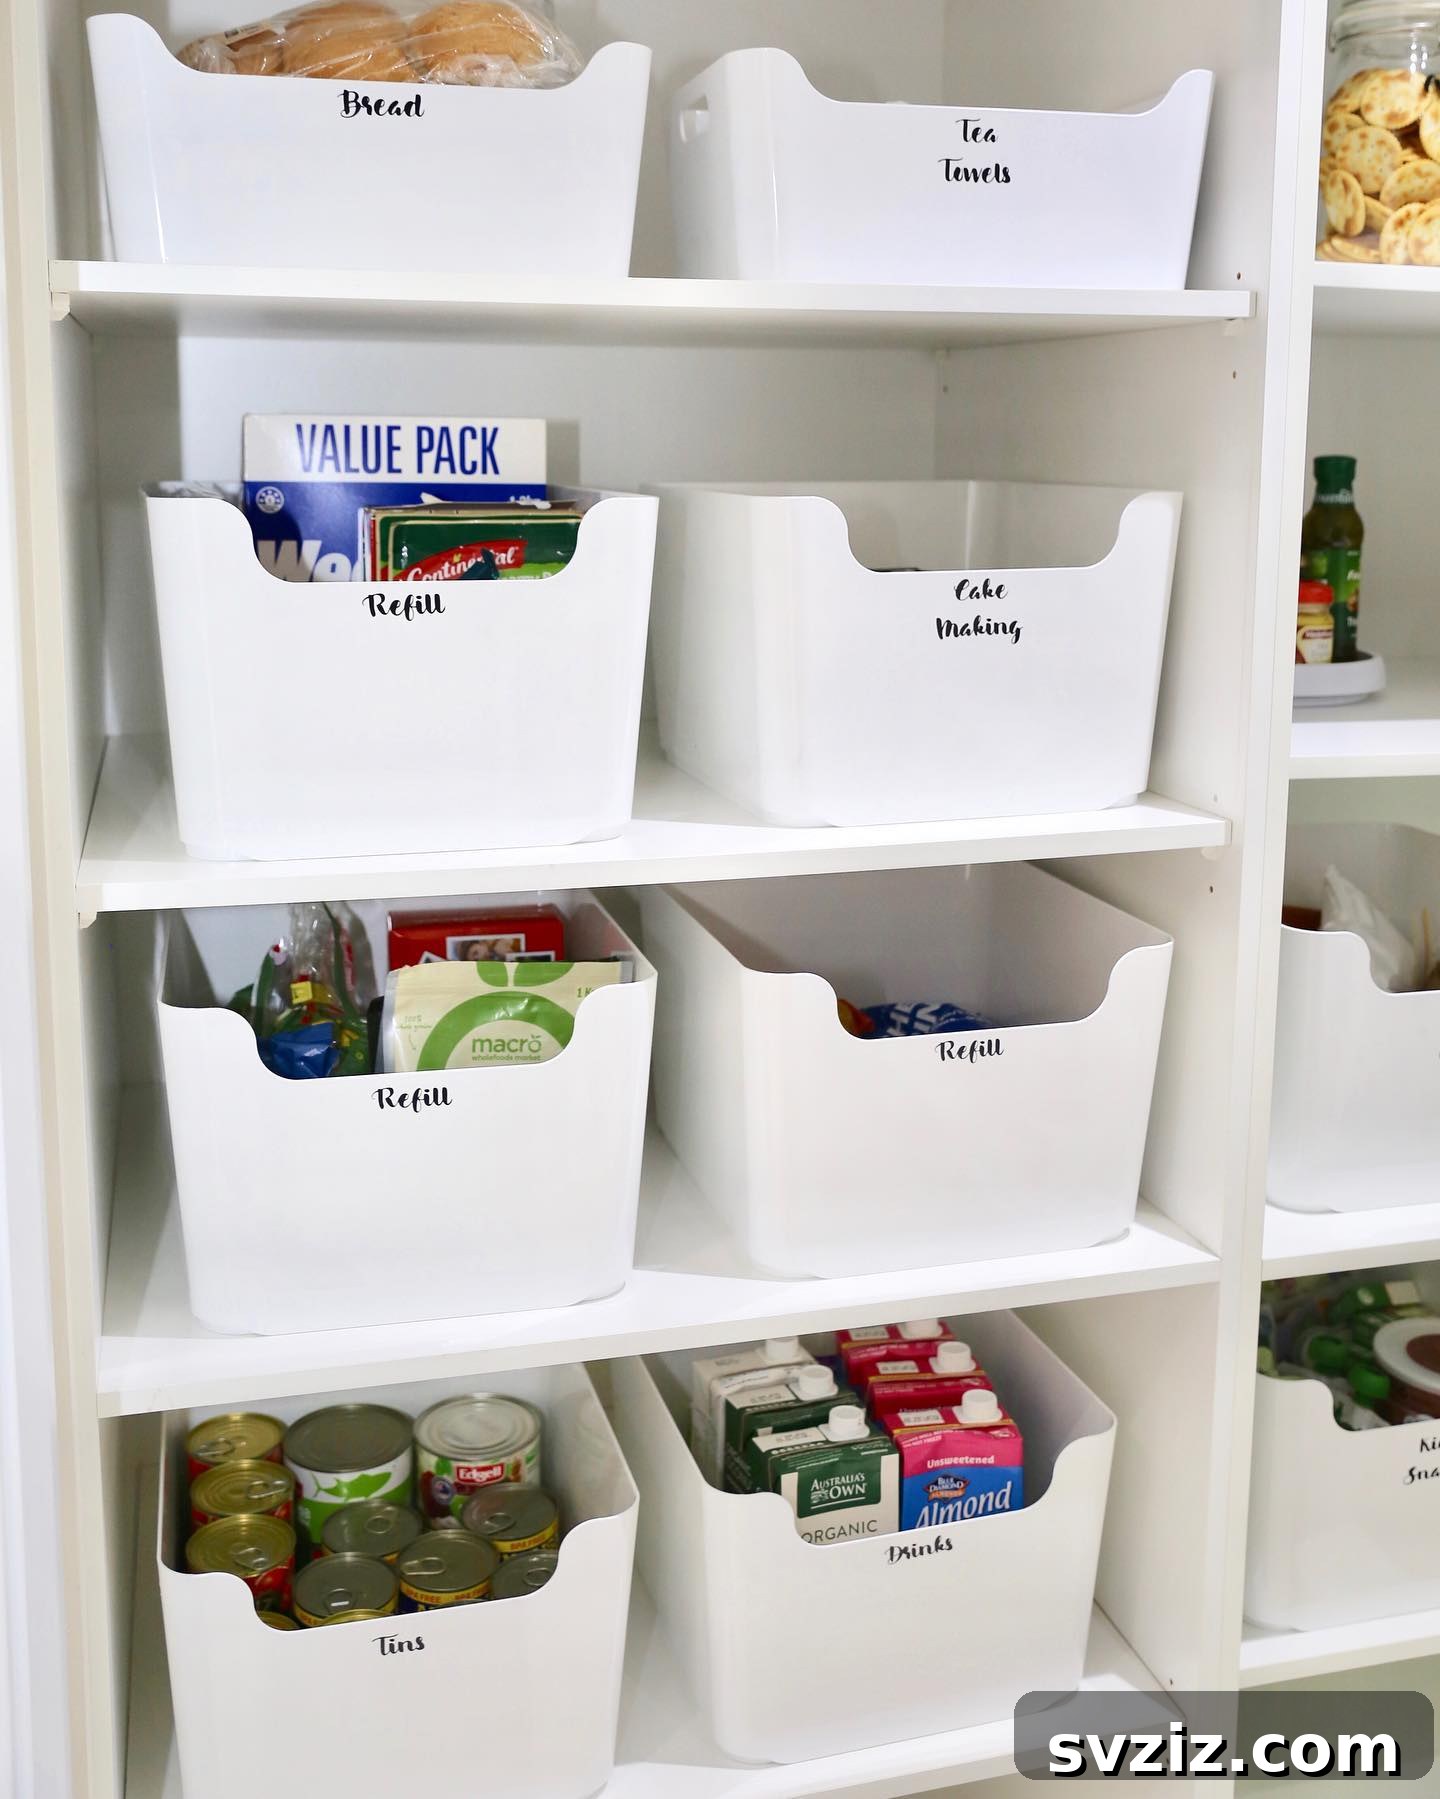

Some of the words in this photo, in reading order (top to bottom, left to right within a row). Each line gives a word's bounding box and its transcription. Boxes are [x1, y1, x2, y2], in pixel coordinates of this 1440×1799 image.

[337, 89, 425, 119] Bread
[955, 118, 999, 143] Tea
[937, 157, 1011, 184] Towels
[296, 423, 402, 474] VALUE
[416, 425, 500, 476] PACK
[257, 539, 371, 582] We
[953, 578, 1009, 601] Cake
[362, 592, 446, 622] Refill
[936, 614, 1023, 645] Making
[472, 1035, 542, 1053] macro
[935, 1038, 1004, 1064] Refill
[370, 1087, 453, 1114] Refill
[927, 1454, 995, 1469] Unsweetened
[829, 1483, 866, 1500] OWN
[915, 1481, 1012, 1529] Almond
[801, 1519, 878, 1544] ORGANIC
[885, 1535, 953, 1565] Drinks
[371, 1633, 425, 1656] Tins
